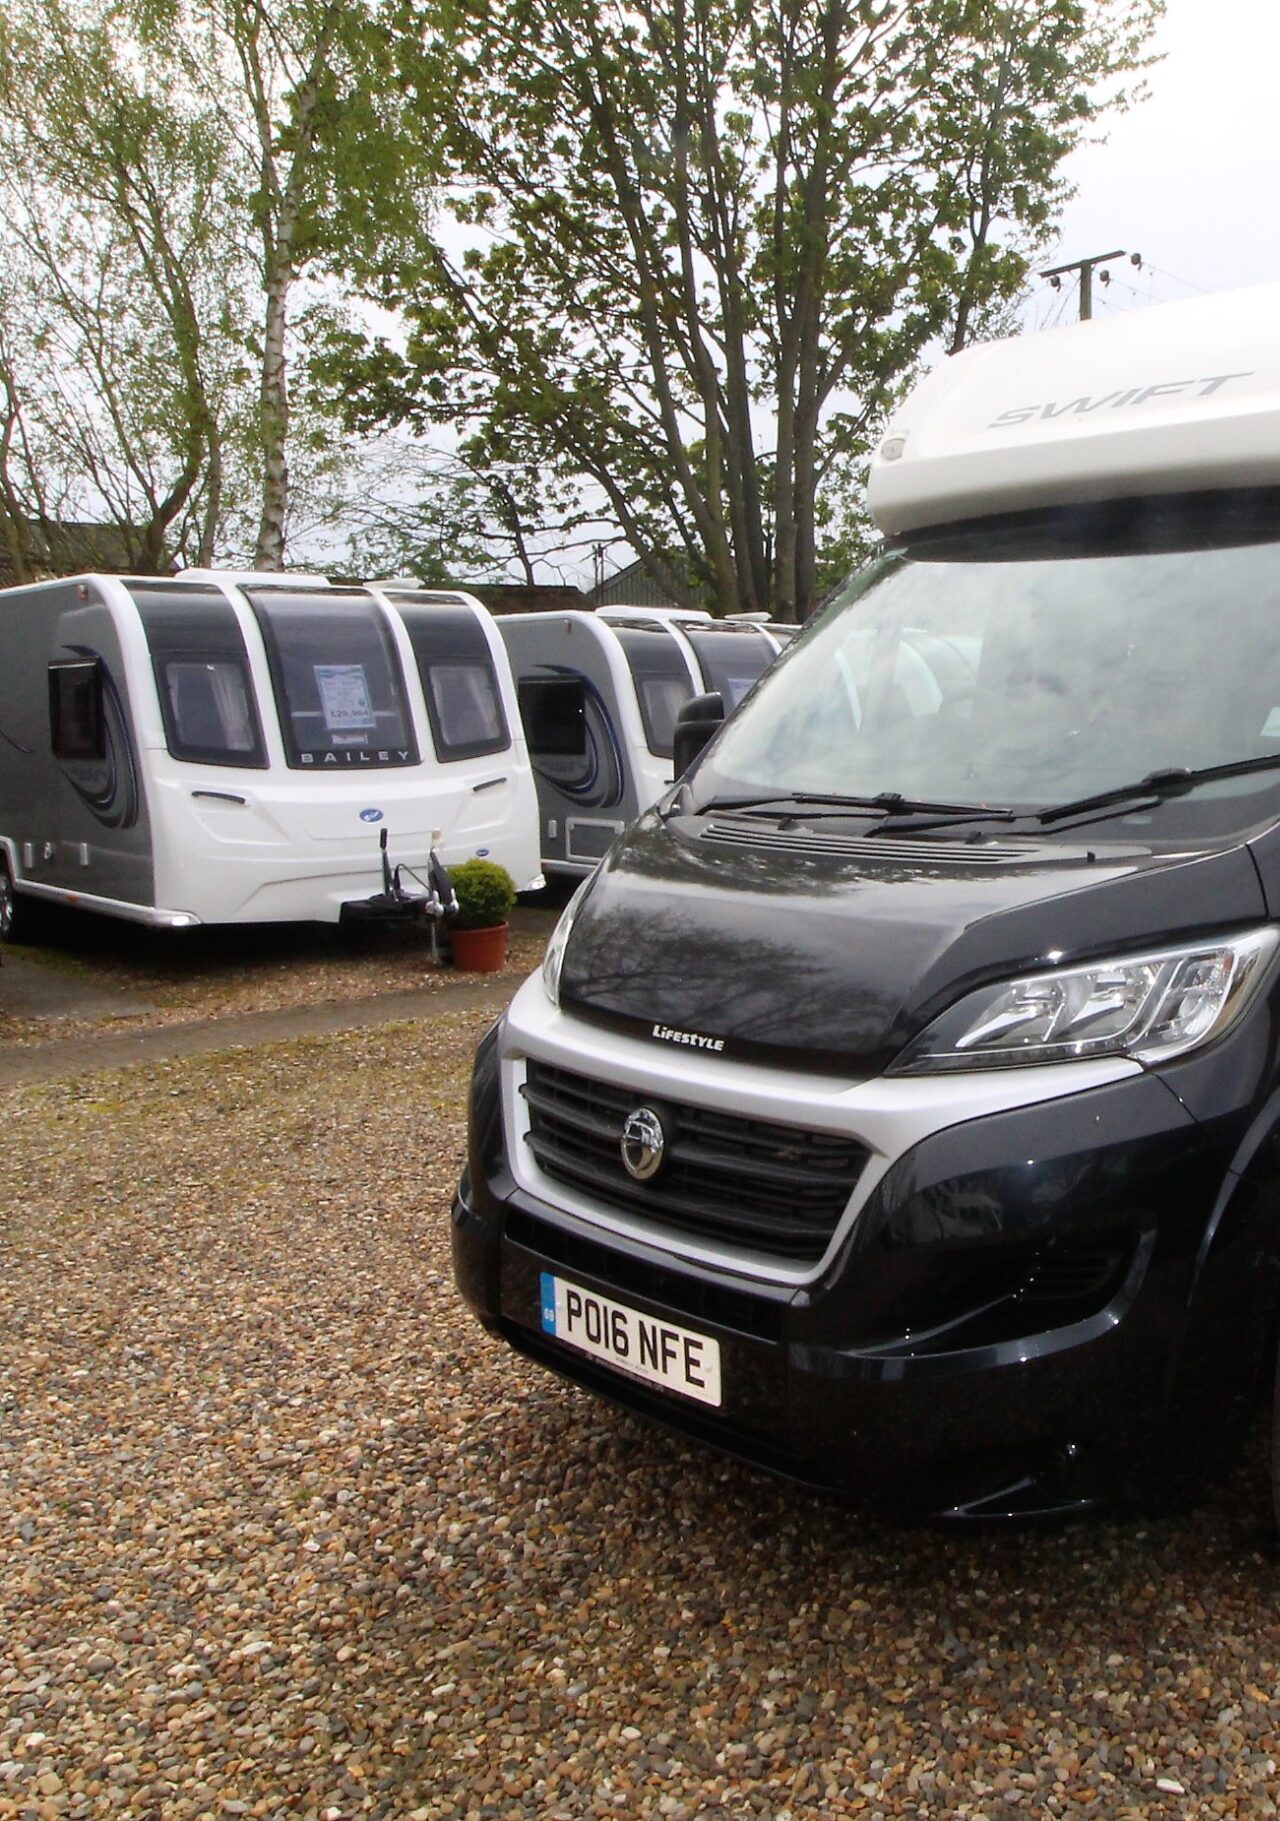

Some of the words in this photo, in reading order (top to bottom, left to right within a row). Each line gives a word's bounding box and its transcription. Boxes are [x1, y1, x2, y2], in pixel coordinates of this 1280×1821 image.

[986, 371, 1255, 428] SWIFT
[301, 751, 408, 763] BAILEY
[566, 1288, 629, 1357] PO16
[638, 1319, 705, 1389] NFE
